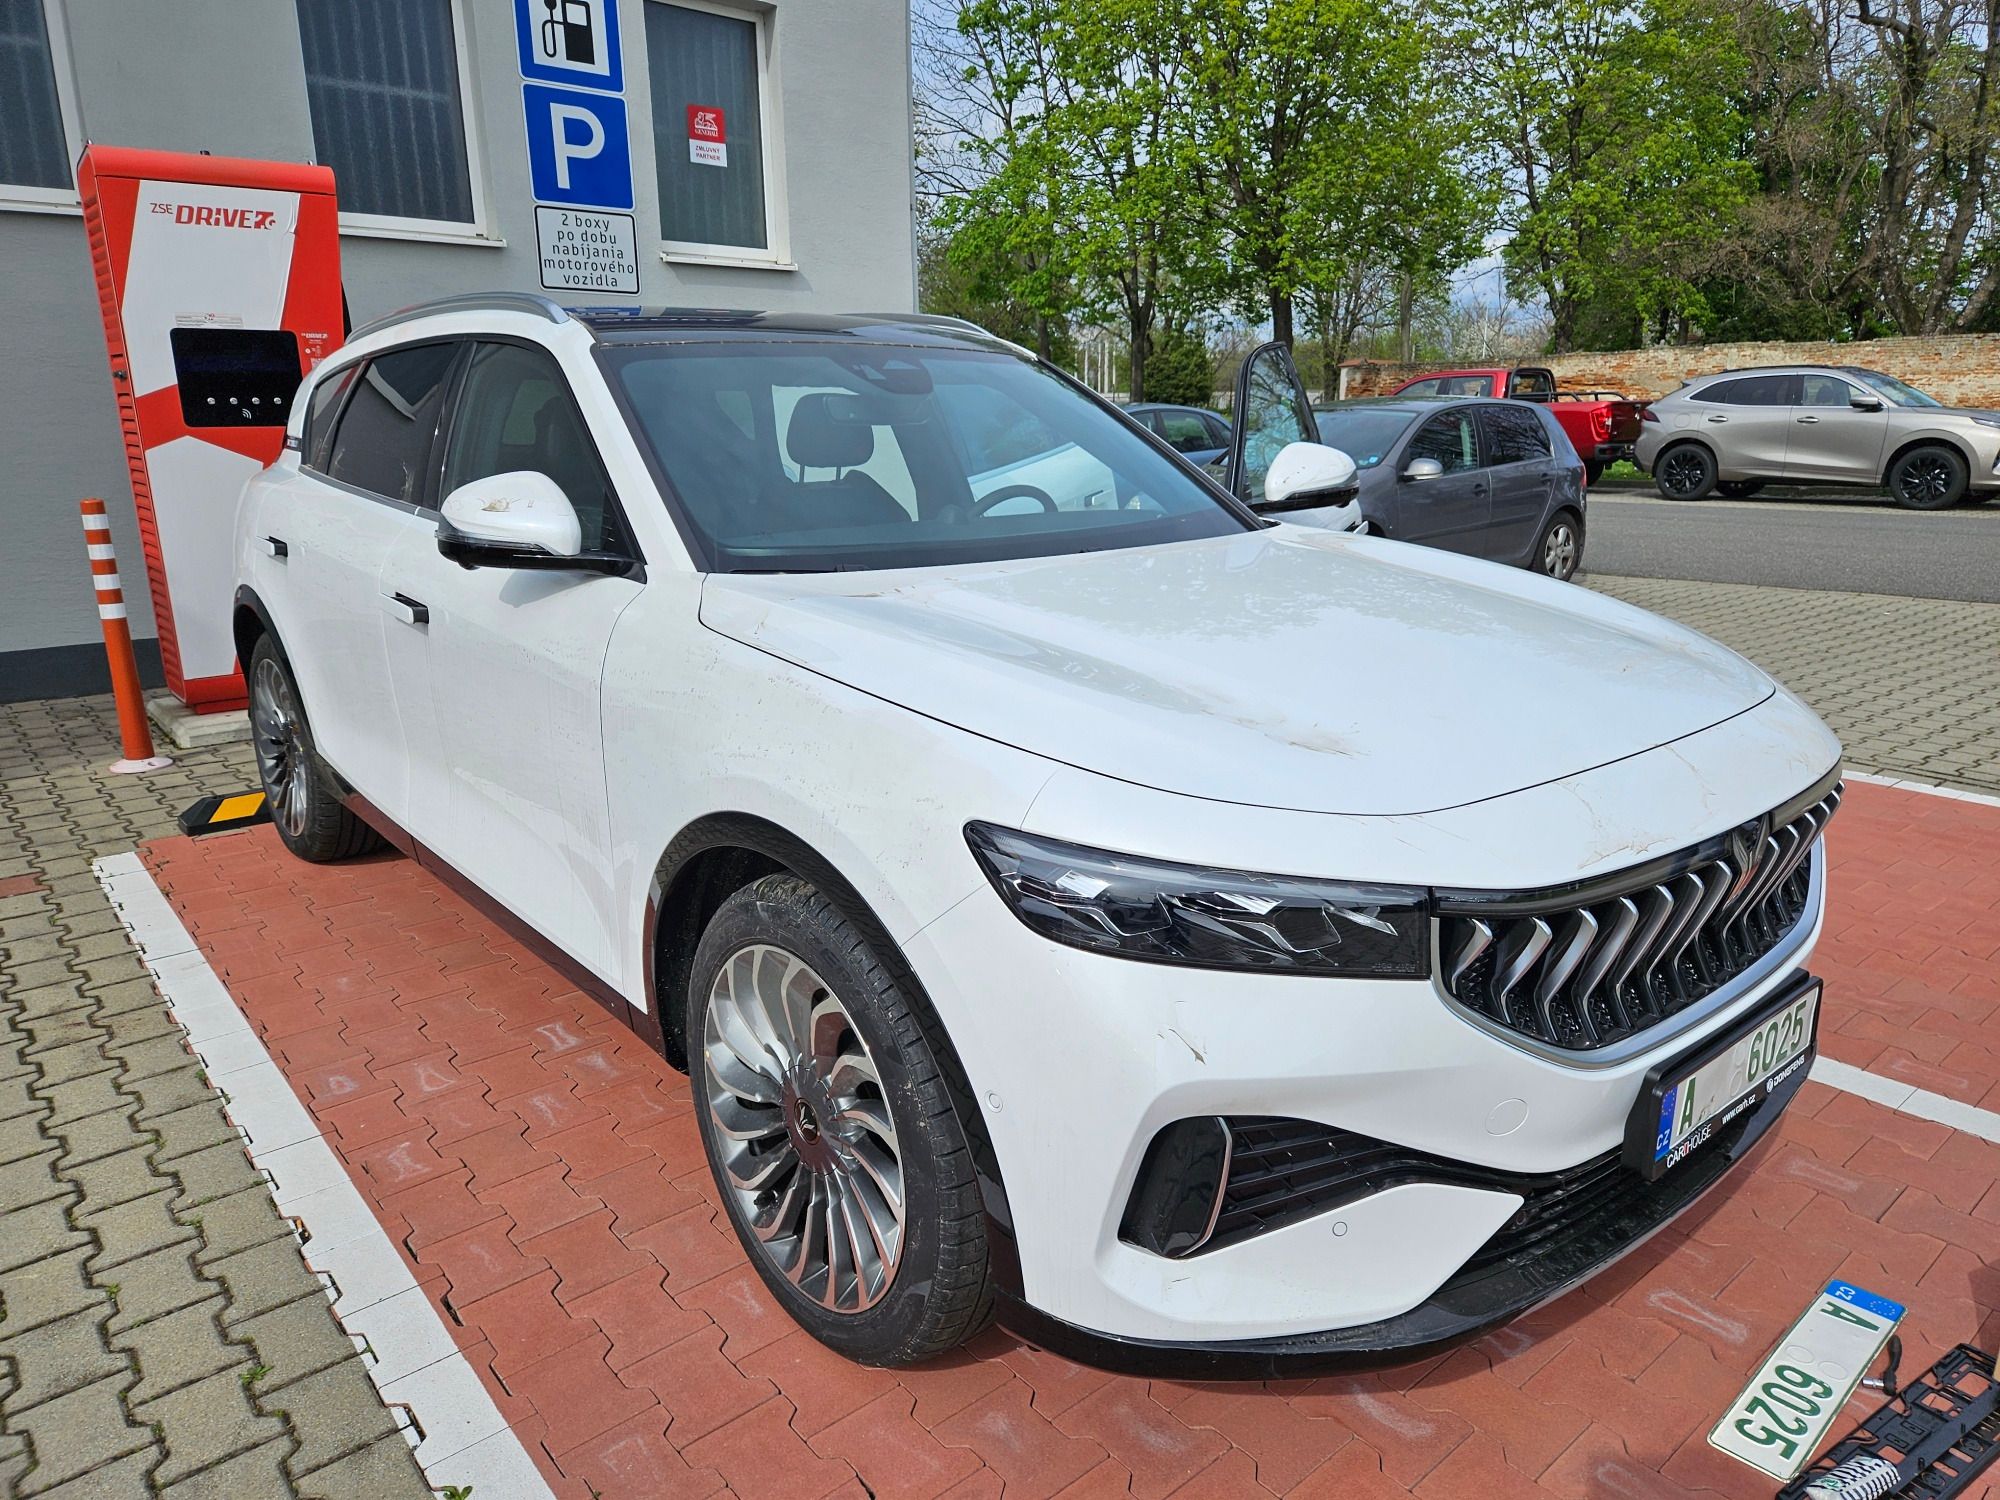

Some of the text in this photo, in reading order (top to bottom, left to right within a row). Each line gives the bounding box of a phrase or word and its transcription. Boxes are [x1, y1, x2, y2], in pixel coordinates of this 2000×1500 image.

[550, 102, 605, 190] P
[695, 152, 721, 161] PARTNER
[150, 202, 174, 215] ZSE
[561, 213, 610, 233] 2 boxy
[557, 229, 617, 245] po dobu
[552, 243, 624, 260] nabíjania
[543, 257, 634, 274] motorového
[563, 272, 618, 287] vozidla
[1677, 1000, 1806, 1136] A 6025
[1656, 1128, 1670, 1151] CZ
[1835, 1286, 1856, 1302] CZ
[1734, 1301, 1880, 1461] A 6025
